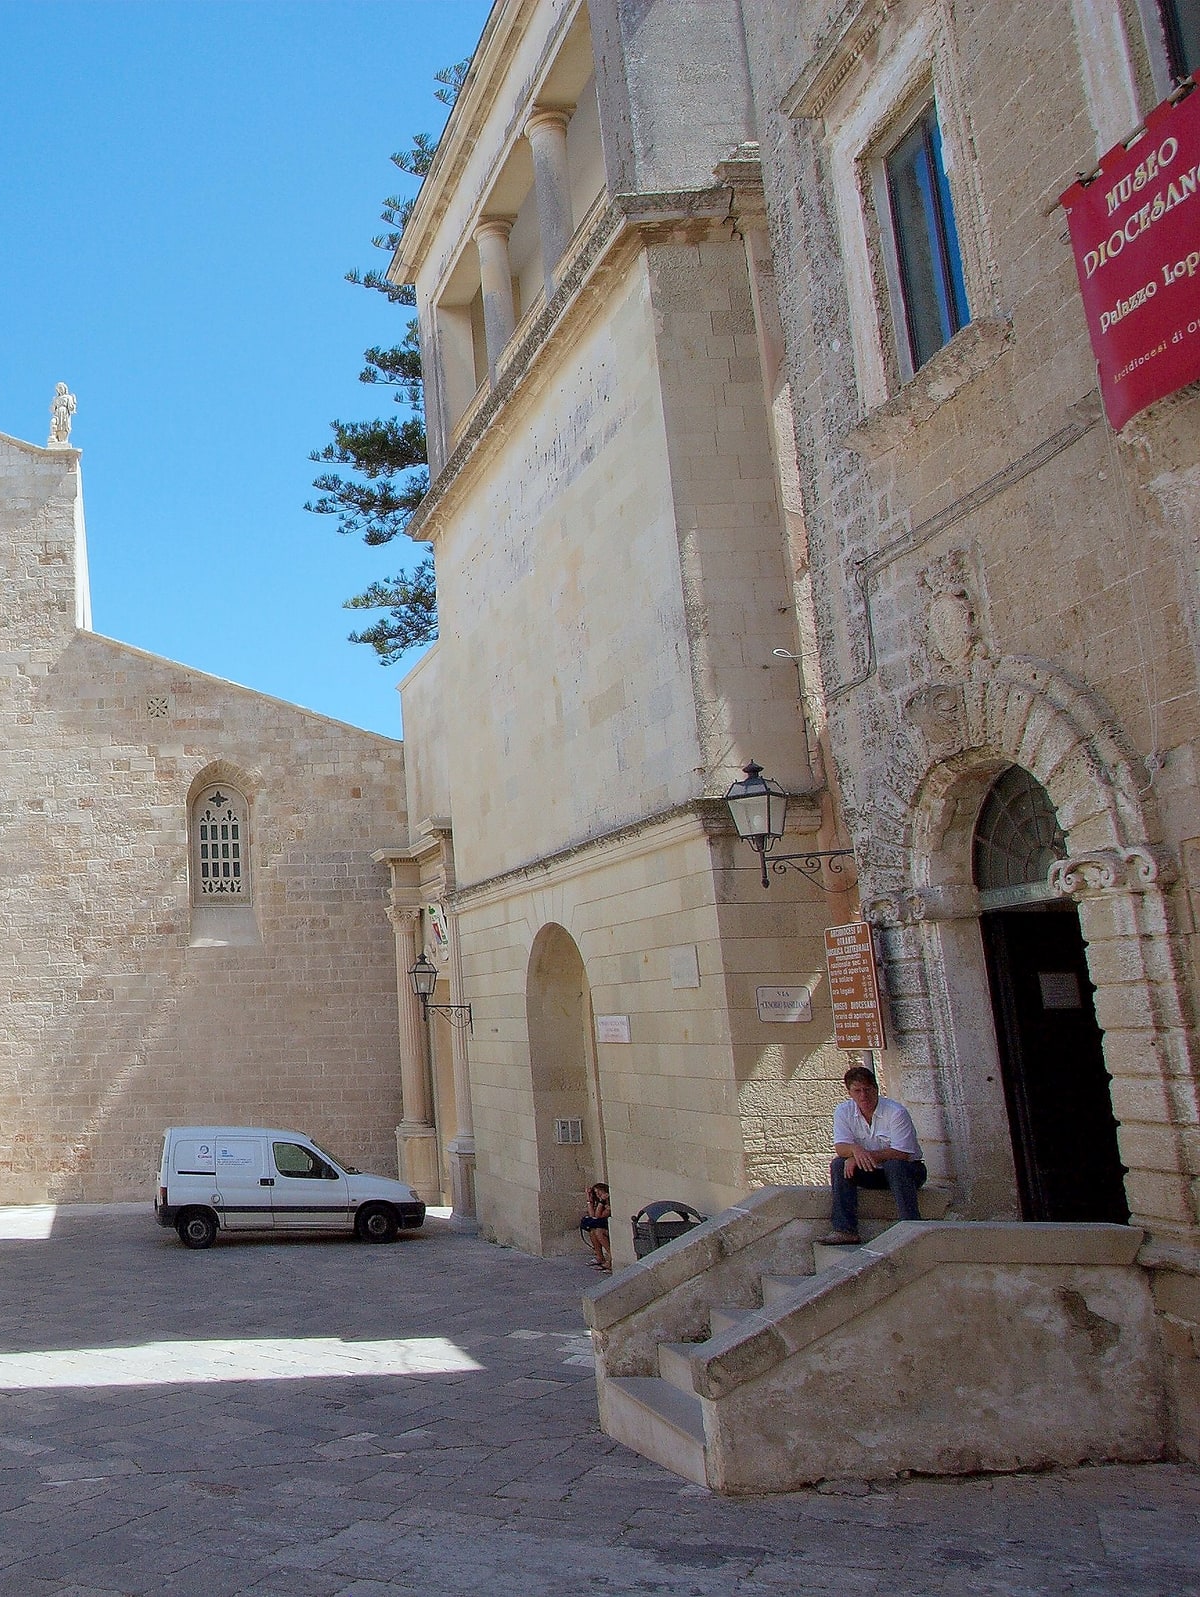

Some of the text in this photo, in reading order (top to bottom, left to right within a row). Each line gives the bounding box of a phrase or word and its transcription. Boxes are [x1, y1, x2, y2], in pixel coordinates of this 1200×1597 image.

[1105, 137, 1178, 217] MUSEO
[1083, 163, 1200, 280] DIOCESAN
[1100, 250, 1200, 334] Palazzo Lop
[1172, 330, 1184, 344] di
